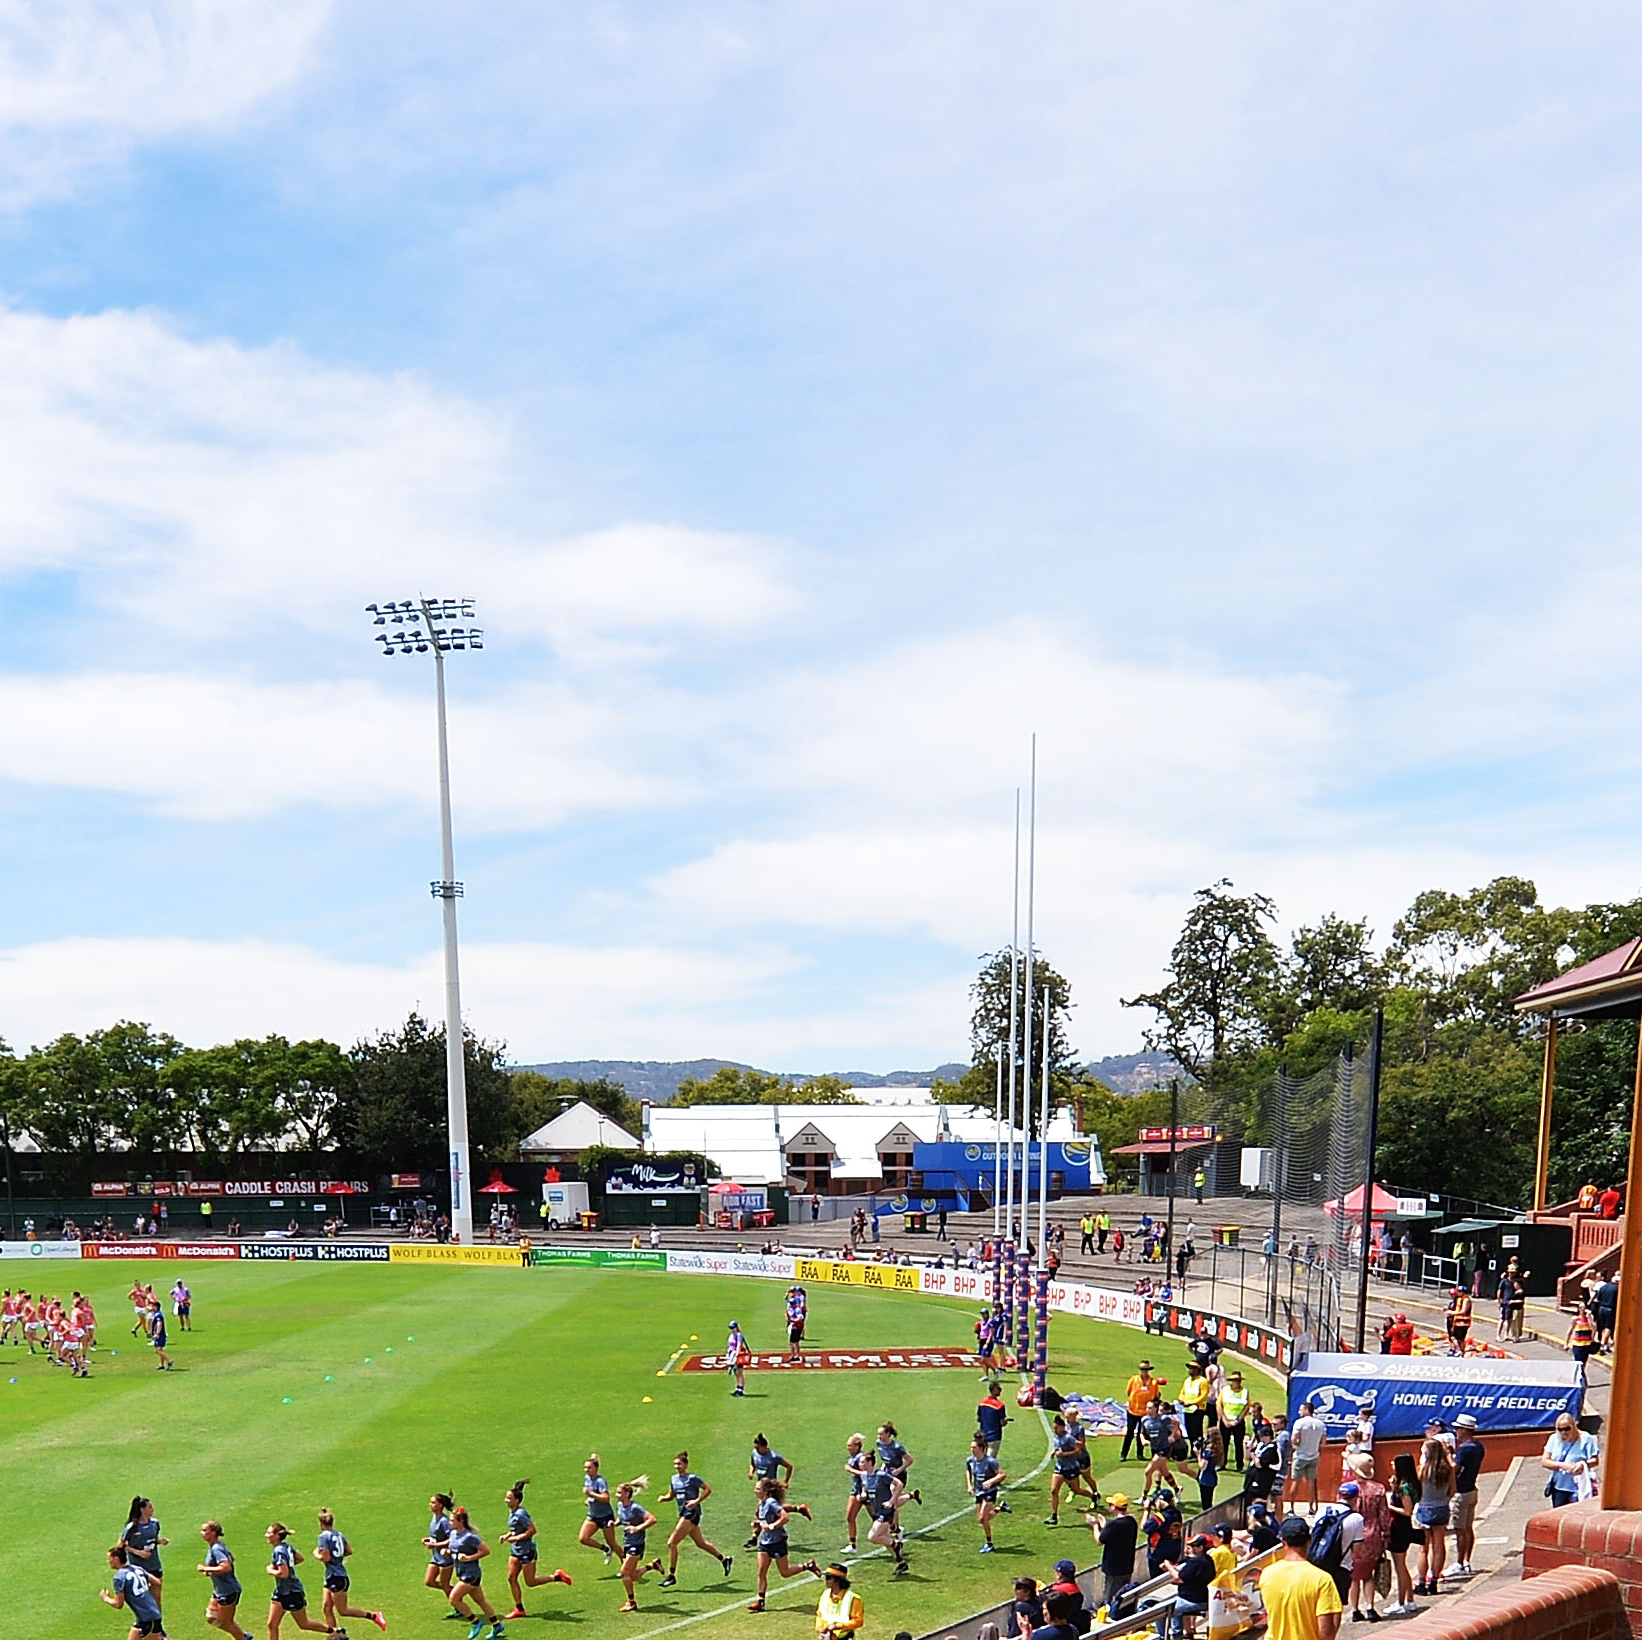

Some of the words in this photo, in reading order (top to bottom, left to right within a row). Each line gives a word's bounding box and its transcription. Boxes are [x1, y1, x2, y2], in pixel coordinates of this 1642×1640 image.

[225, 1181, 271, 1194] CADDLE
[275, 1181, 316, 1194] CRASH
[99, 1245, 157, 1255] McDonald's
[178, 1246, 235, 1256] McDonald's
[260, 1246, 313, 1258] HOSTPLUS
[337, 1247, 388, 1259] HOSTPLUS
[393, 1249, 422, 1258] WOLF
[426, 1249, 457, 1259] BLASS
[463, 1251, 493, 1260] WOLF
[496, 1251, 522, 1261] BLAS
[538, 1250, 566, 1258] THOMAS
[924, 1272, 946, 1290] BHP
[954, 1275, 976, 1294] BHP
[1098, 1295, 1117, 1315] BHP
[1123, 1299, 1141, 1320] BHP
[1178, 1311, 1193, 1330] nab
[1226, 1320, 1239, 1342] nab
[1247, 1329, 1259, 1350] nab
[1386, 1363, 1494, 1376] AUSTRALIAN
[1392, 1393, 1437, 1406] HOME
[1442, 1395, 1462, 1407] OF
[1466, 1396, 1496, 1408] THE
[1498, 1397, 1568, 1411] REDLEGS
[332, 1535, 345, 1557] 31
[126, 1567, 149, 1597] 26
